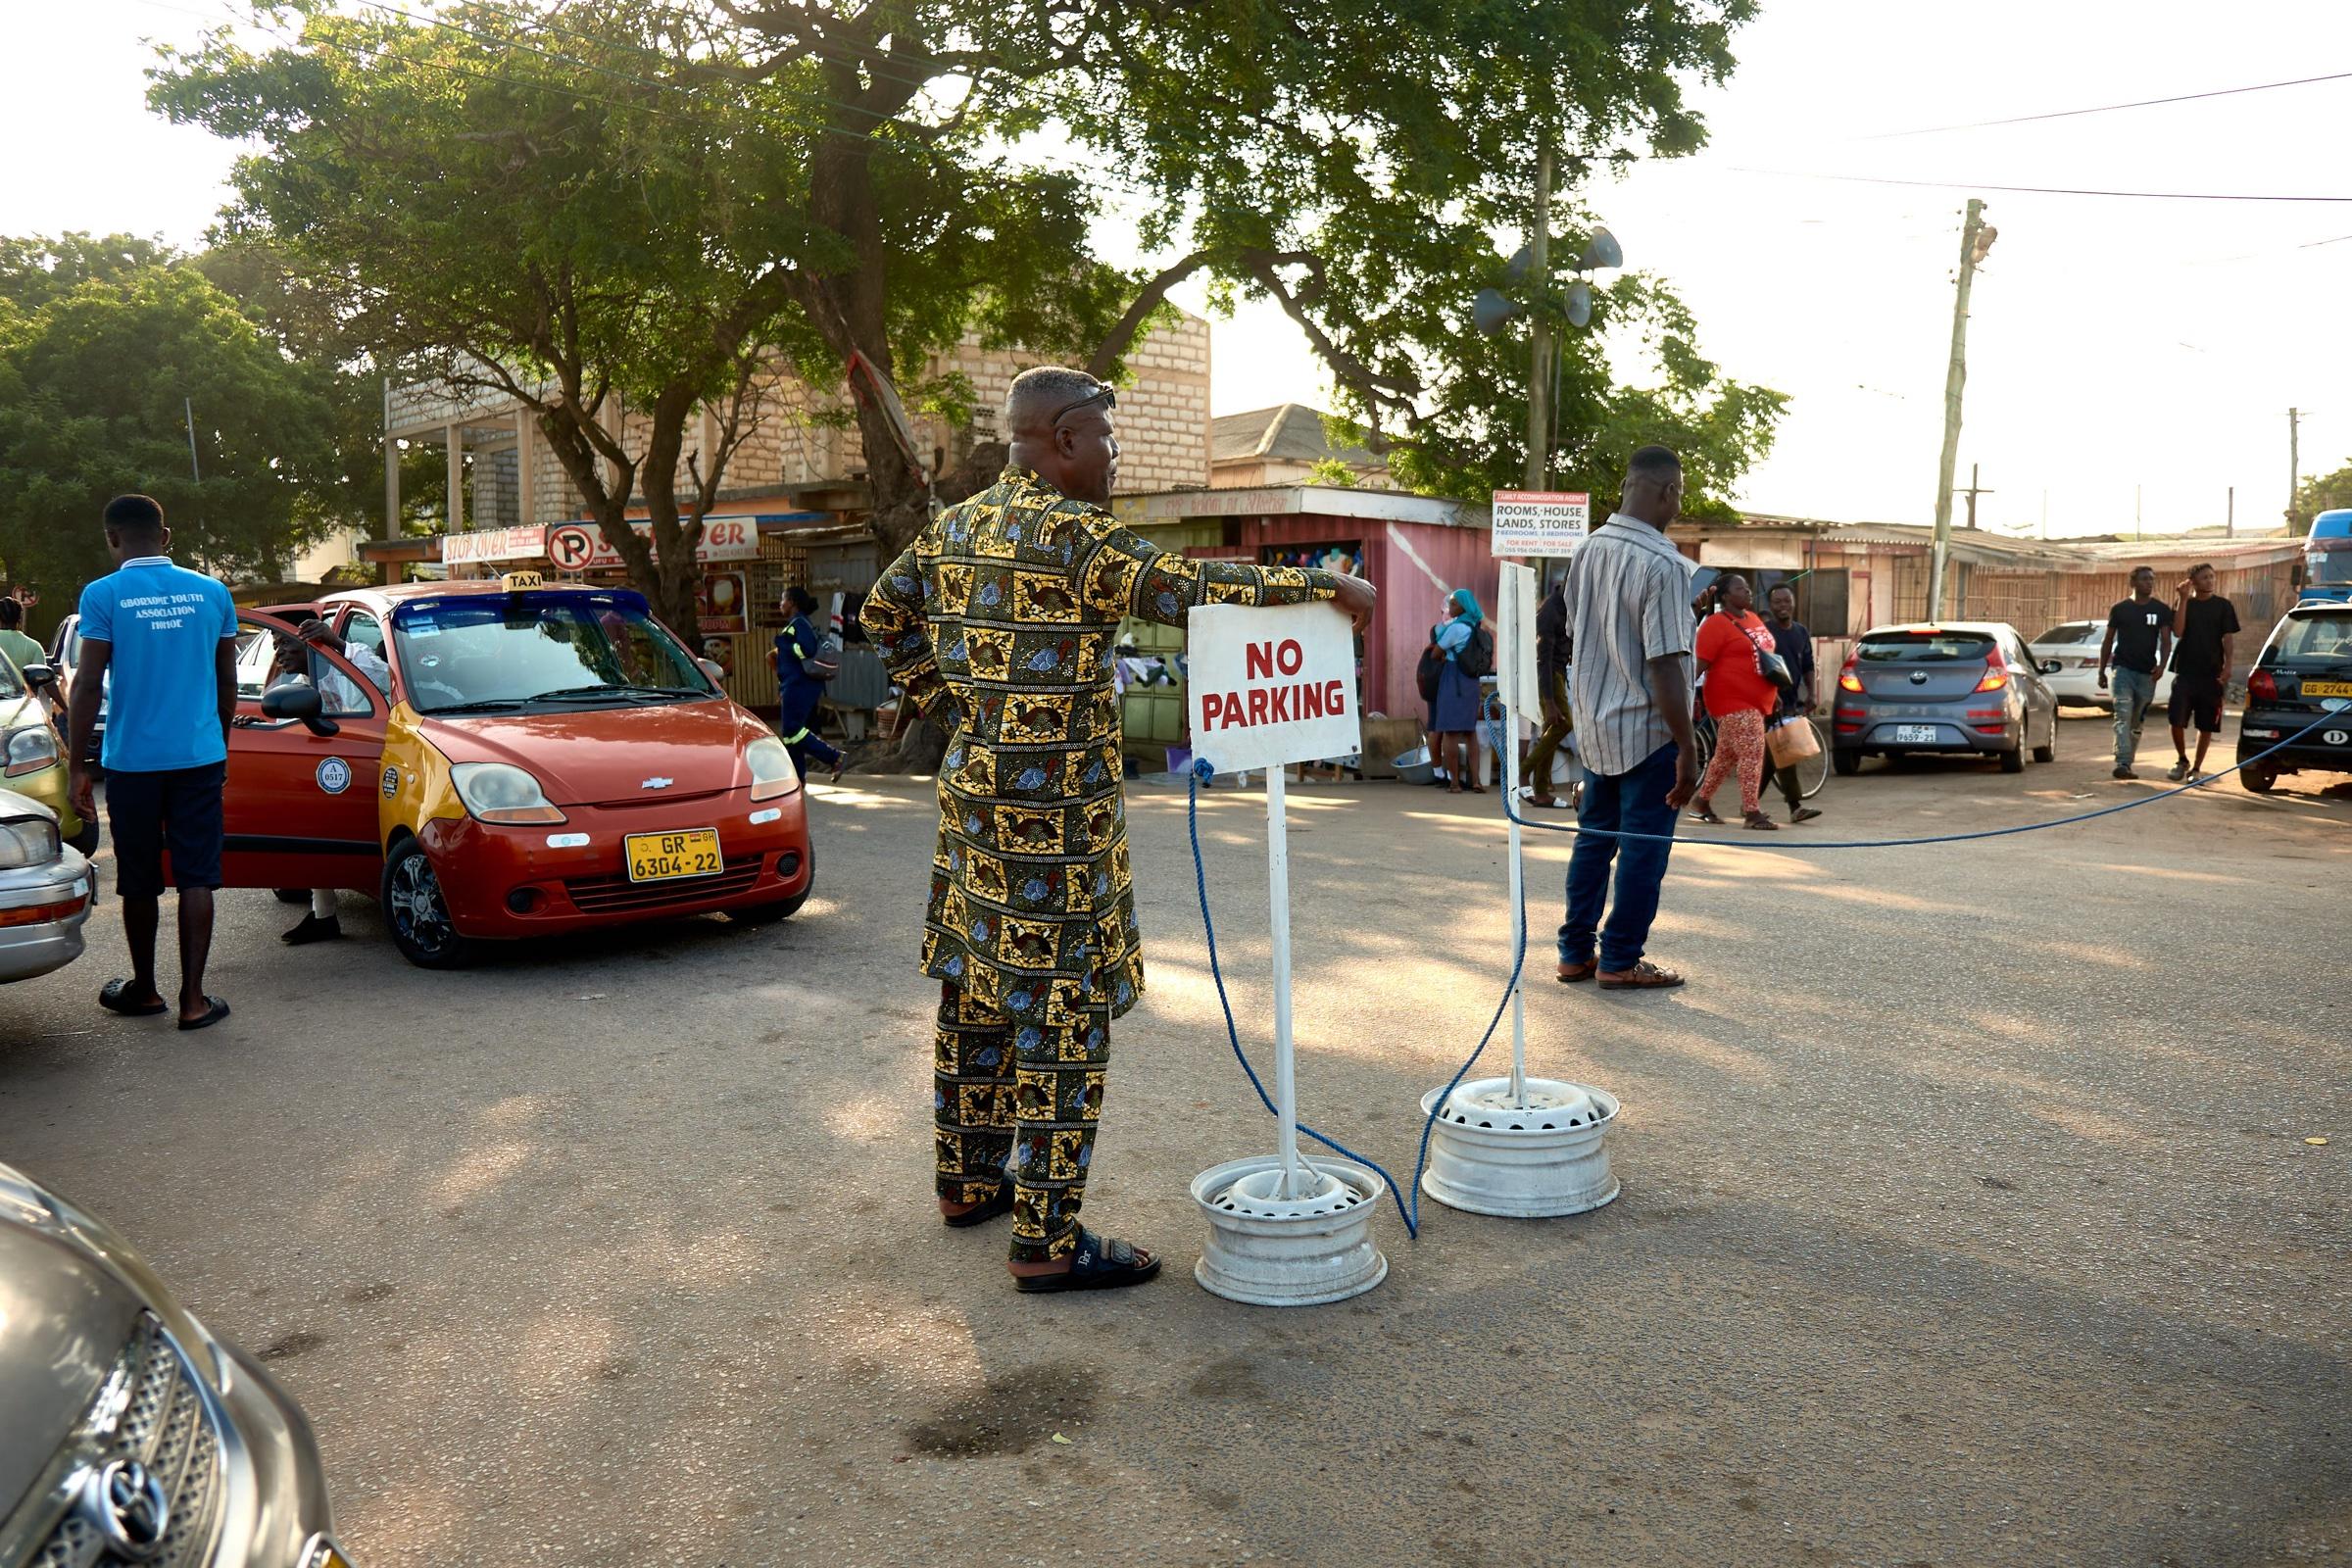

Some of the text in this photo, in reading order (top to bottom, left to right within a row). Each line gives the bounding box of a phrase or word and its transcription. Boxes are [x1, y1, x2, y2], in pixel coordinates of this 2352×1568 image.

[1496, 506, 1585, 517] ROOMS, HOUSE,
[1496, 518, 1581, 530] LANDS, STORES
[446, 535, 472, 561] STOP
[476, 532, 507, 558] OVER
[510, 575, 541, 587] TAXI
[170, 594, 204, 604] YOUTH
[135, 606, 196, 618] ASSOCIATION
[2146, 613, 2157, 625] 11
[1247, 639, 1302, 680] NO
[1201, 680, 1345, 732] PARKING
[2329, 732, 2343, 742] D
[662, 832, 714, 854] GR GH
